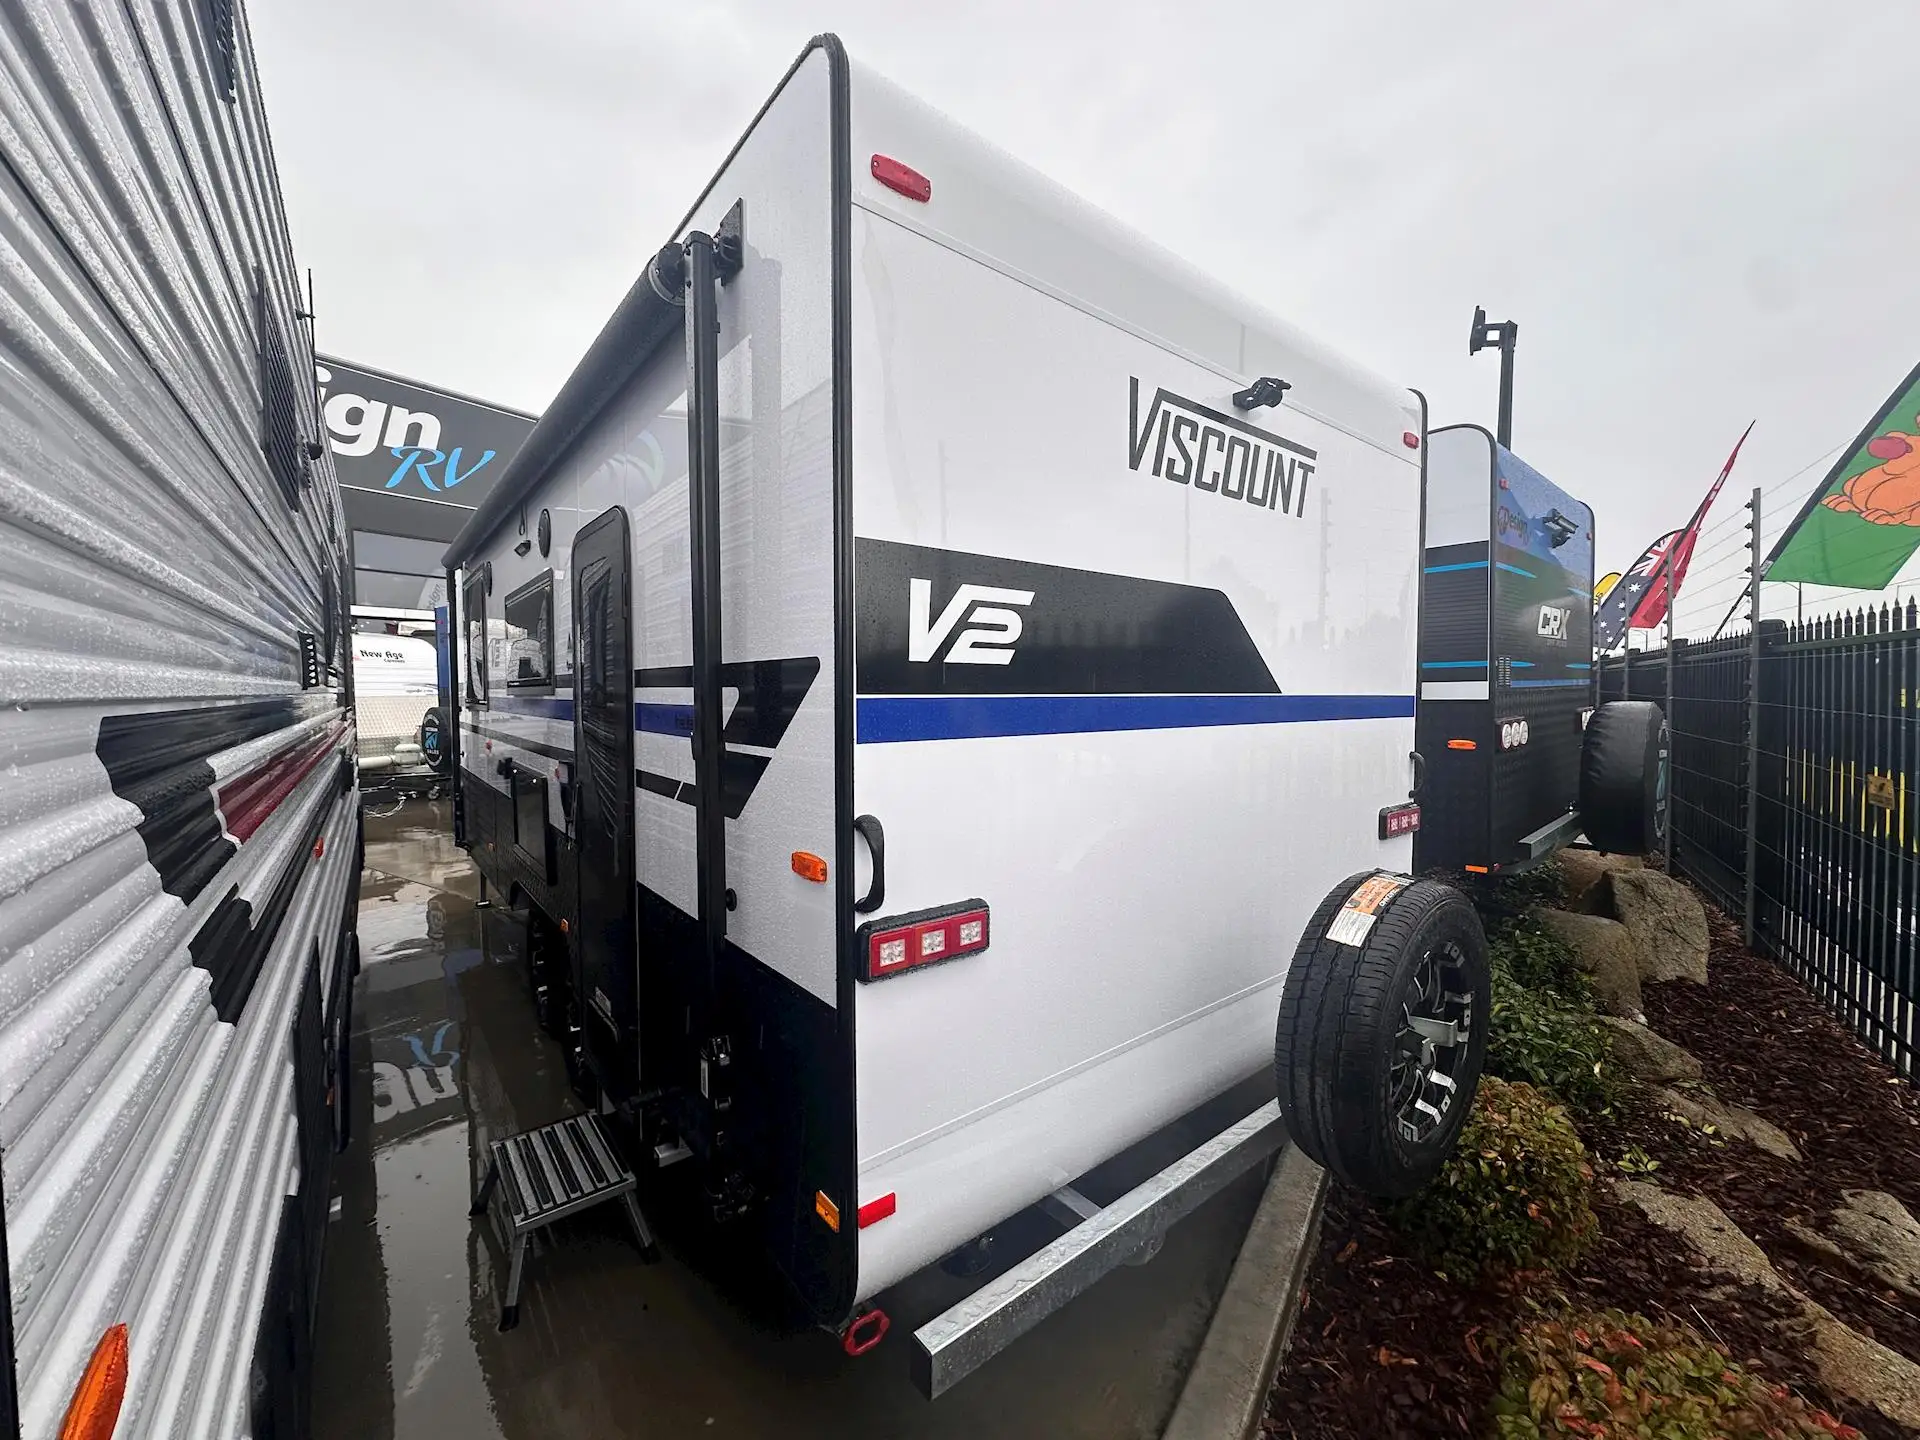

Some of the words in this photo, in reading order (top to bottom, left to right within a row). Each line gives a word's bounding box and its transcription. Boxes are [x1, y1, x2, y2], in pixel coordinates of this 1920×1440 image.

[385, 446, 496, 492] RV
[1129, 376, 1317, 518] VISCOUNT
[909, 578, 1035, 665] V2
[1538, 605, 1571, 640] CRX
[360, 649, 382, 658] New
[385, 650, 404, 660] Age
